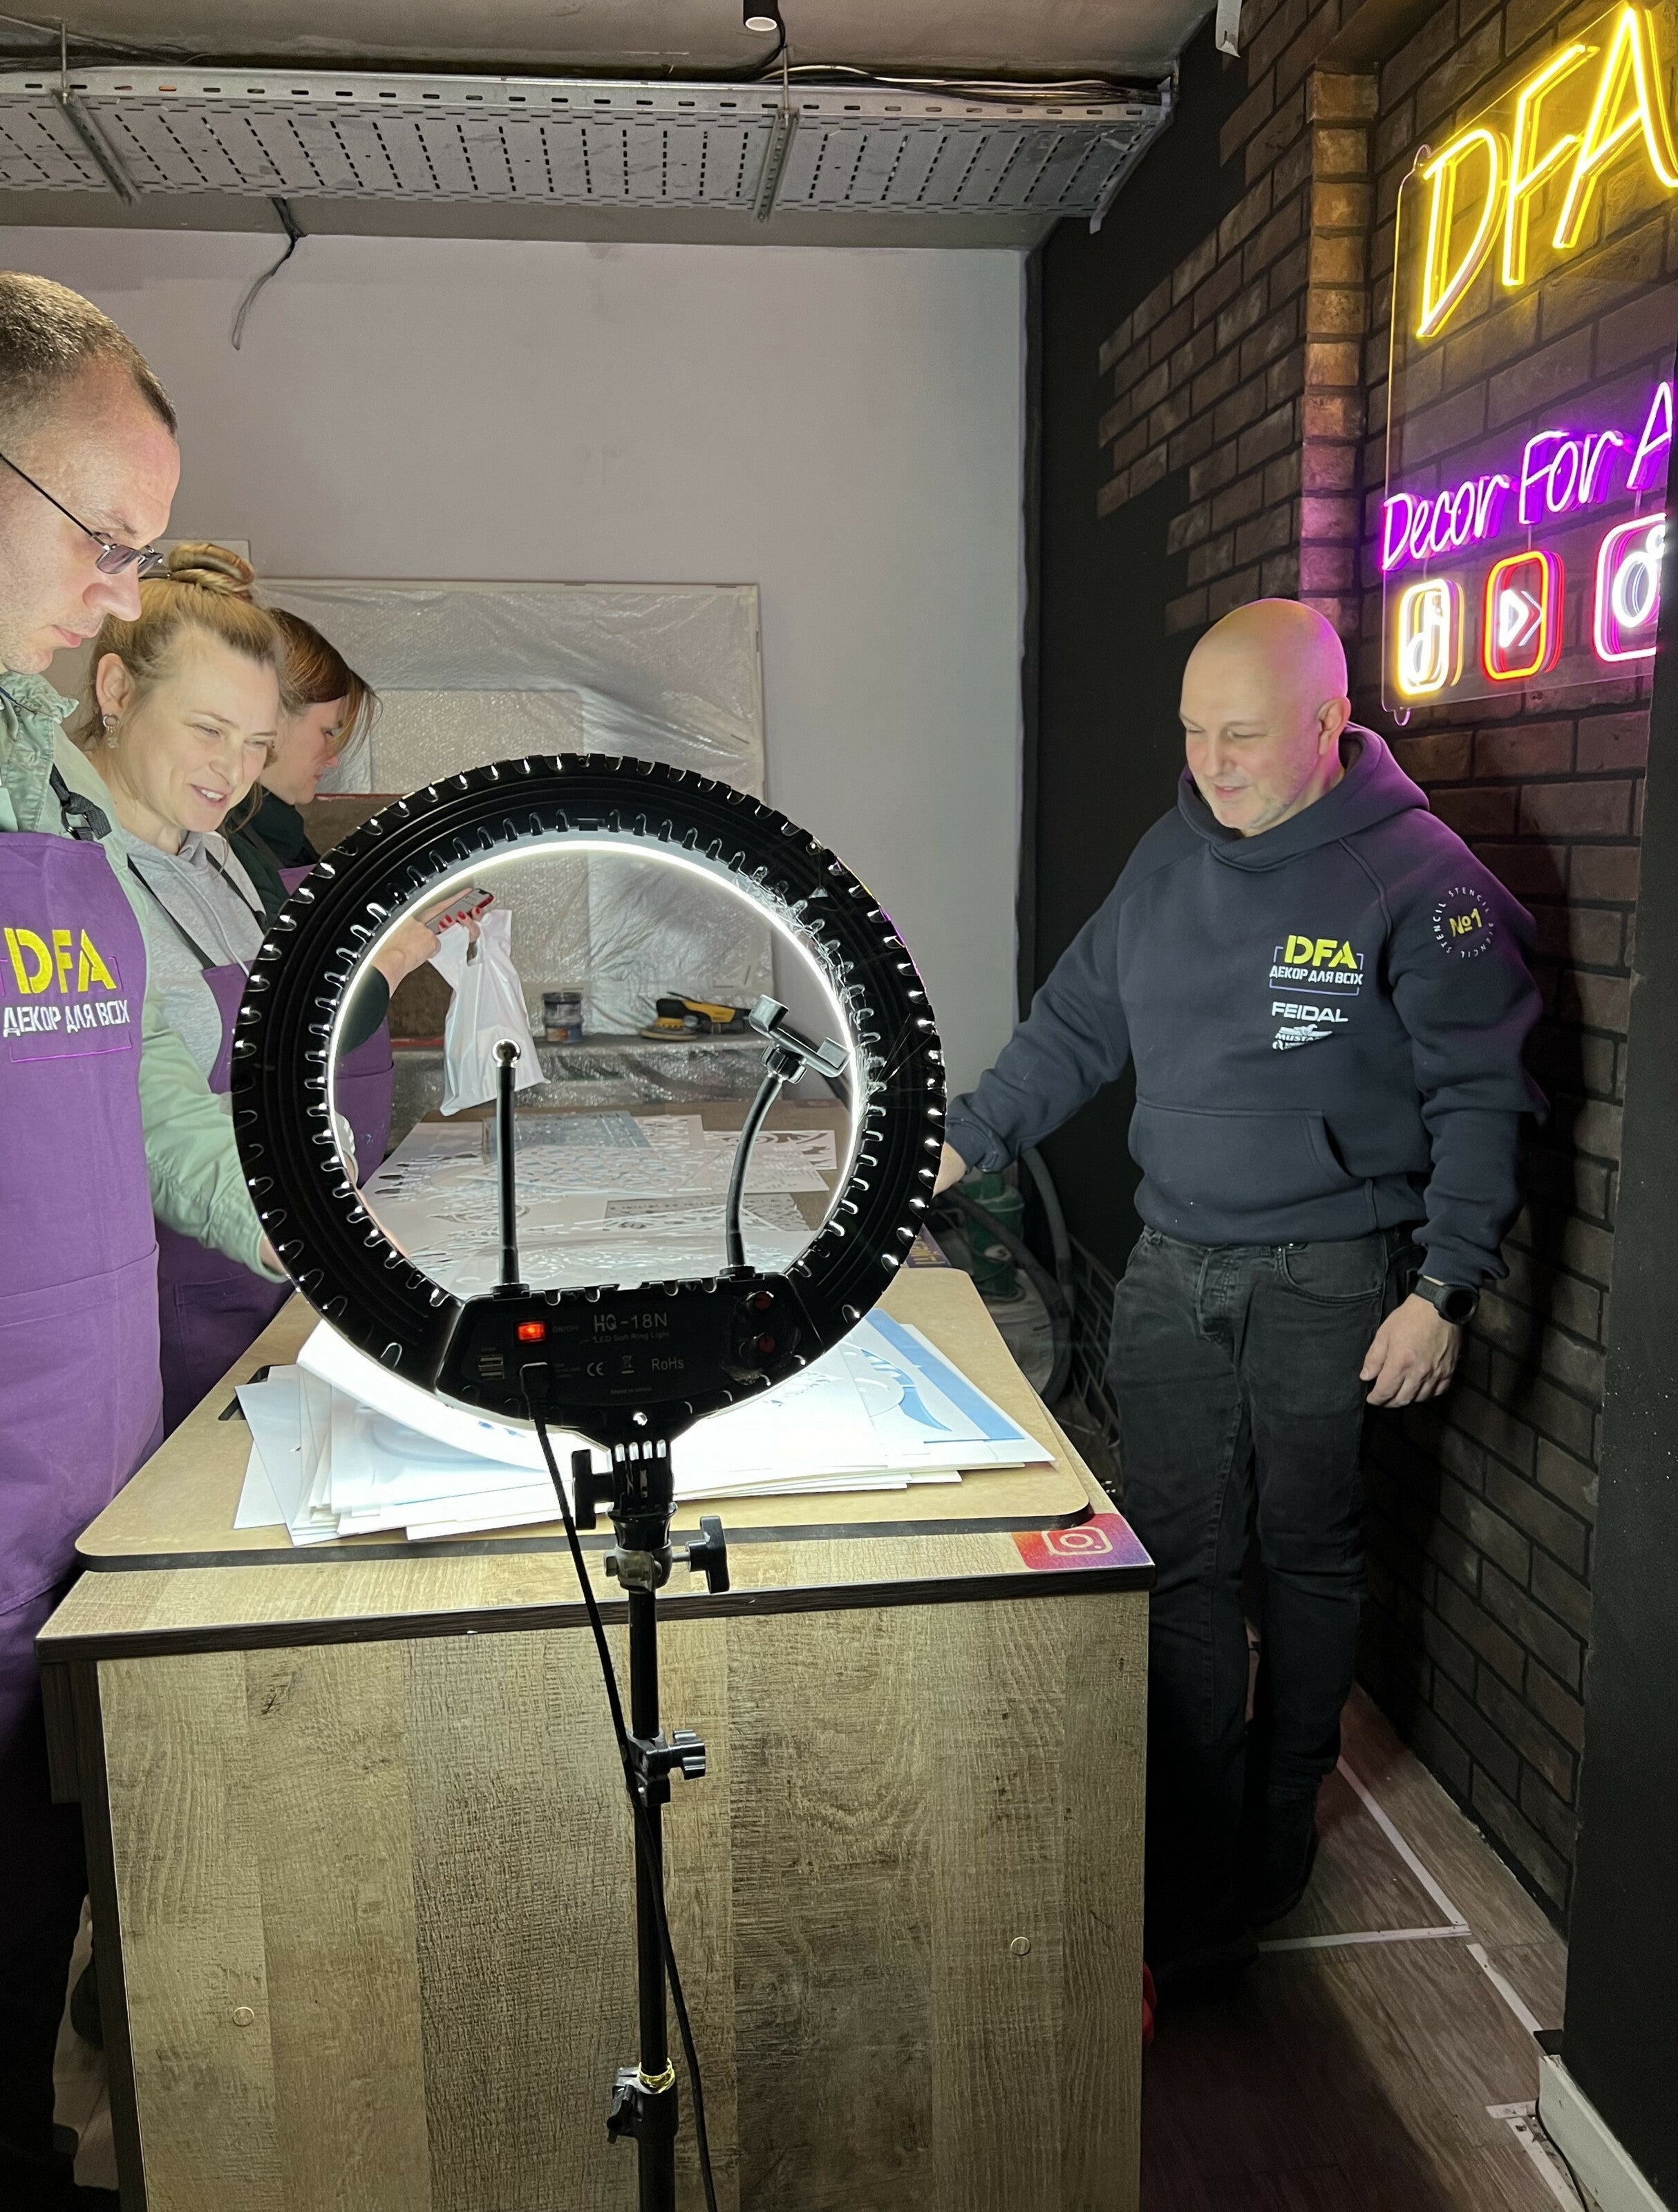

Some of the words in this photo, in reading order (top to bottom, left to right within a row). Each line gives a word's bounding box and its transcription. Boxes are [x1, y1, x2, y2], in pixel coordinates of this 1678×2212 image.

[1416, 6, 1678, 337] DFA
[1382, 474, 1509, 570] Decor
[1518, 429, 1623, 525] For
[1433, 902, 1453, 954] STENCIL
[3, 927, 117, 994] DFA
[1283, 935, 1358, 969] DFA
[1269, 965, 1308, 980] ДЕКОР
[1308, 970, 1335, 984] ДЛЯ
[1335, 972, 1364, 986] ВСІХ
[3, 1005, 62, 1038] ДЕКОР
[65, 1004, 97, 1033] ДЛЯ
[1271, 1001, 1349, 1022] FEIDAL
[1274, 1032, 1320, 1042] MUSTA
[594, 1312, 668, 1333] HQ-18N
[651, 1356, 685, 1371] RoHs
